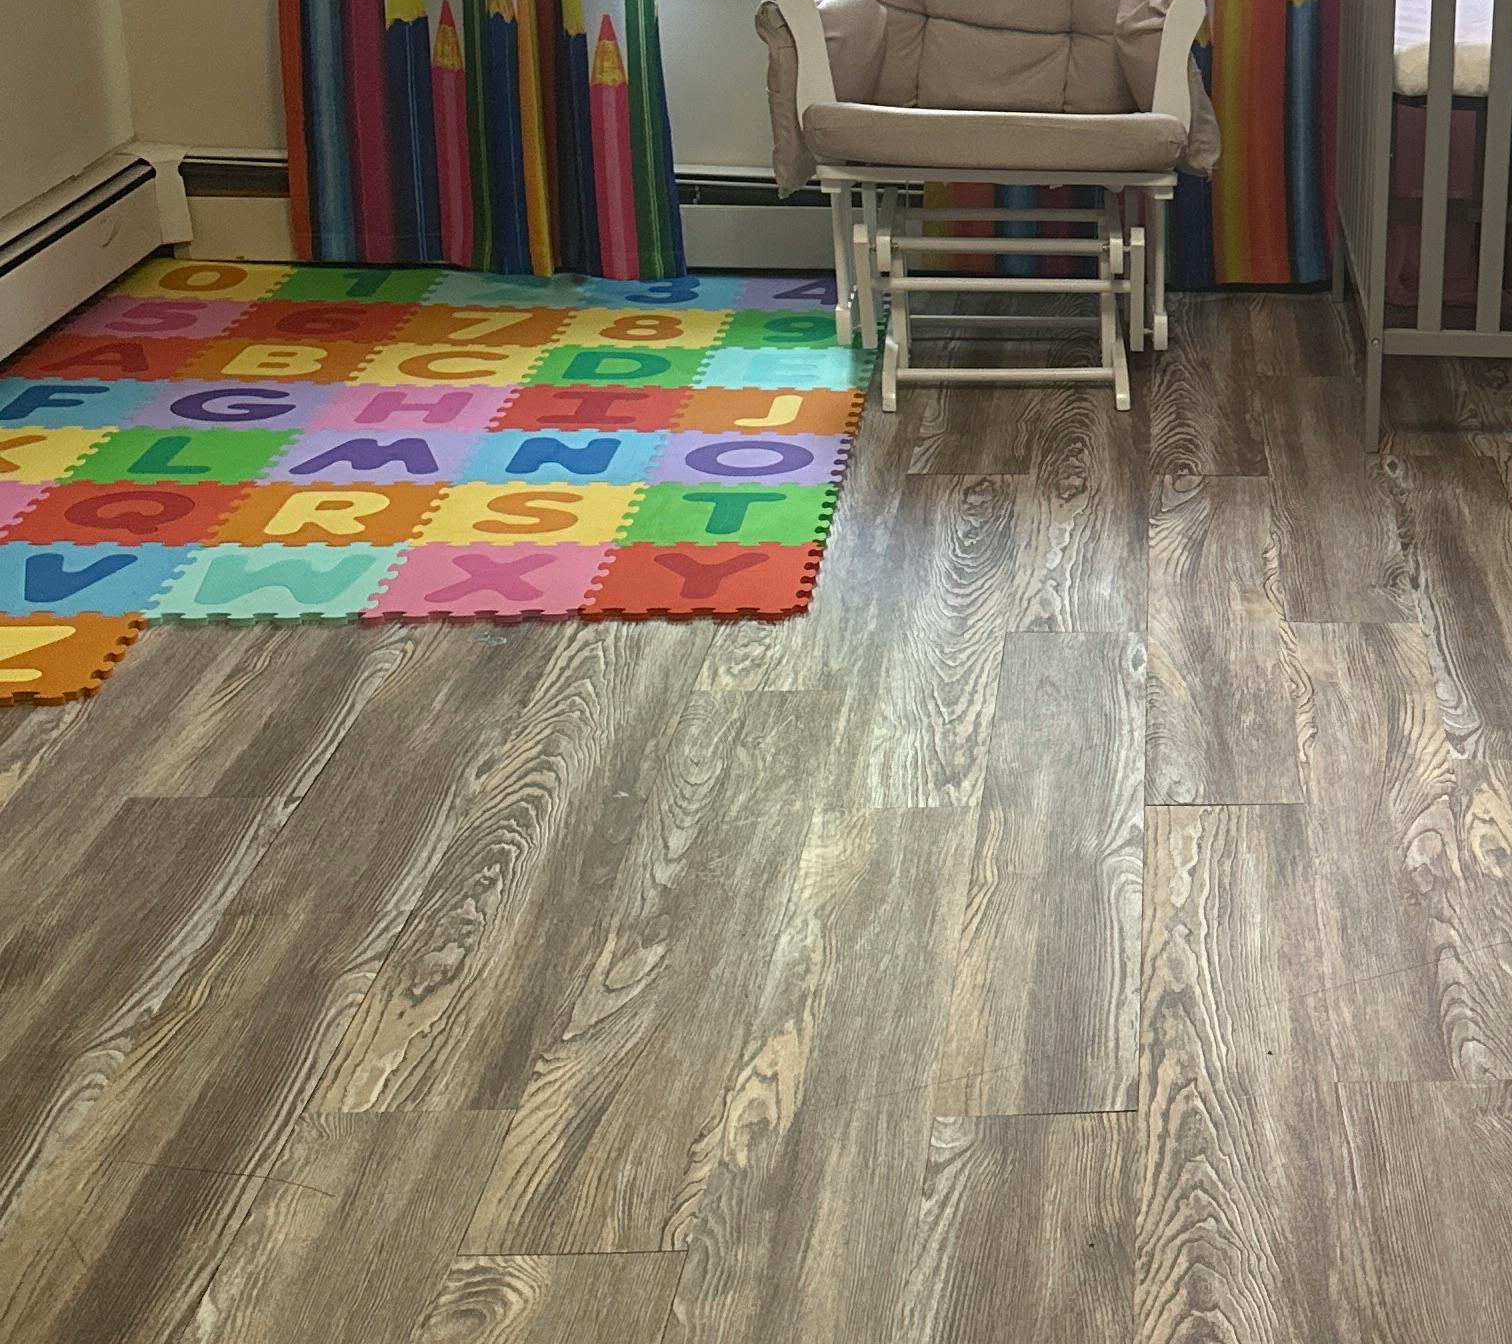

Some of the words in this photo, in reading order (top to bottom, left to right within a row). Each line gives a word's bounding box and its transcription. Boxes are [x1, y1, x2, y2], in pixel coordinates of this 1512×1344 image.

[158, 264, 248, 292] 0
[343, 270, 393, 297] 1
[624, 276, 701, 304] 3
[772, 278, 838, 306] 4
[104, 301, 209, 333] 5
[275, 307, 368, 336] 6
[449, 312, 533, 341] 7
[599, 315, 684, 341] 8
[762, 315, 839, 343] 9
[40, 343, 150, 374] A
[220, 344, 328, 377] B
[397, 350, 510, 380] C
[562, 351, 672, 380] D
[743, 353, 827, 383] E
[0, 385, 110, 421] F
[170, 387, 297, 422] G
[353, 391, 474, 424] H
[536, 391, 650, 425] I
[733, 394, 803, 427] J
[127, 436, 212, 475] L
[288, 437, 440, 475] M
[504, 437, 622, 475] N
[684, 439, 815, 477] O
[64, 490, 196, 535] Q
[263, 490, 391, 536] R
[472, 491, 584, 534] S
[682, 492, 788, 535] T
[24, 553, 139, 603] V
[194, 554, 379, 605] W
[423, 553, 558, 603] X
[653, 552, 770, 600] Y
